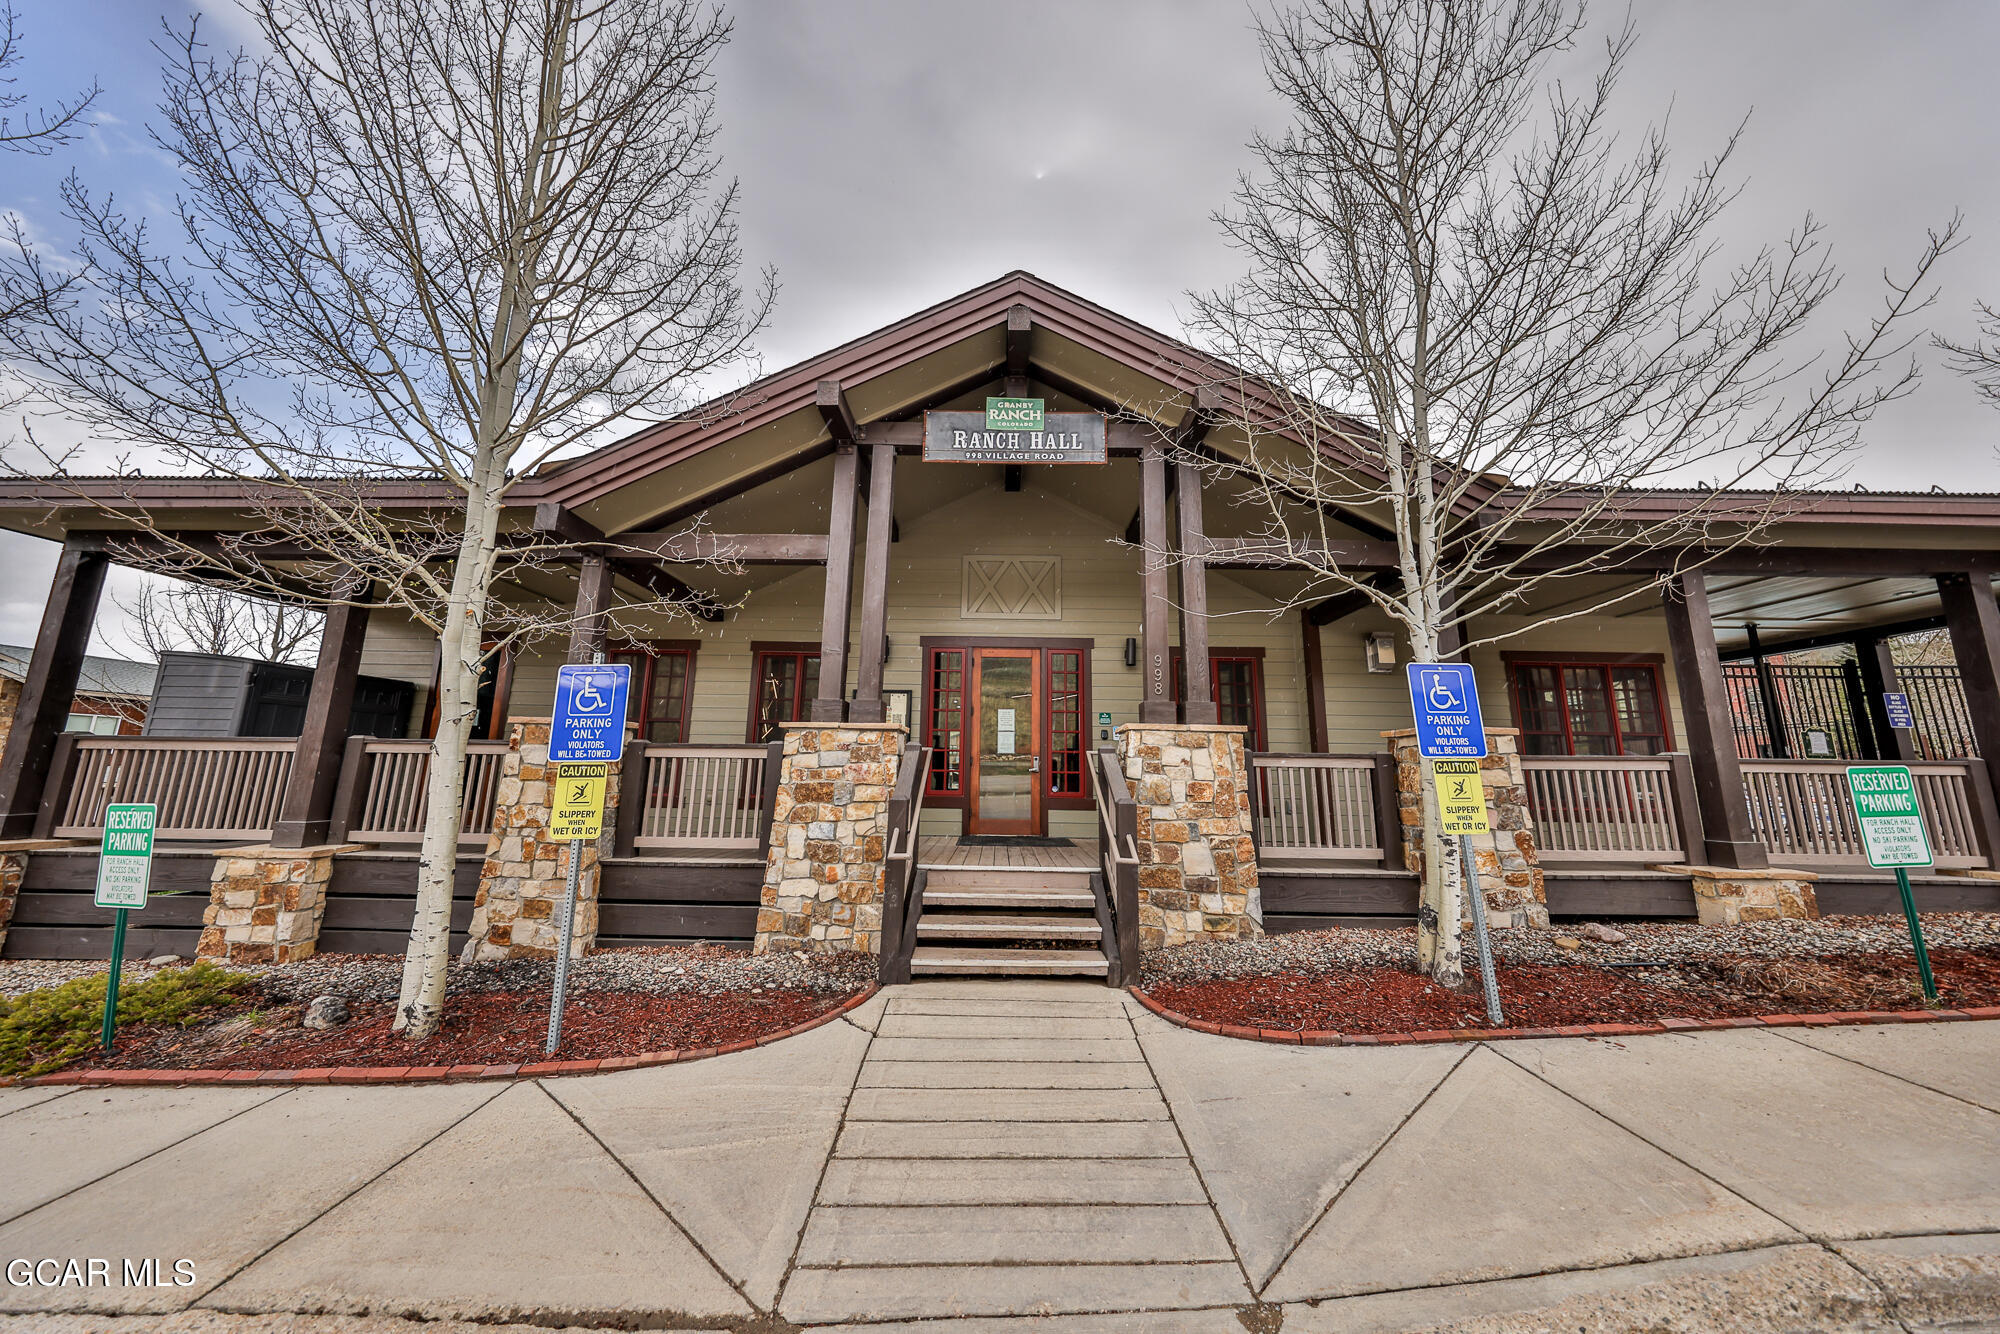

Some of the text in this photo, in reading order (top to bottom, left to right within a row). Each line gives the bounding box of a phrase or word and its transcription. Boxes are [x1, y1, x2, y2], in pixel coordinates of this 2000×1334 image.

[989, 409, 1042, 420] RANCH
[953, 430, 1083, 450] RANCH HALL
[985, 452, 1030, 460] VILLAGE
[1154, 654, 1163, 695] 998
[565, 718, 612, 728] PARKING
[1427, 715, 1471, 725] PARKING
[572, 729, 602, 739] ONLY
[1436, 726, 1463, 736] ONLY
[568, 741, 605, 749] VIOLATORS
[1435, 737, 1469, 746] VIOLATORS
[557, 750, 611, 758] WILL BE TOWED
[1428, 746, 1478, 754] WILL BE TOWED
[561, 765, 605, 777] CAUTION
[1436, 762, 1477, 773] CAUTION
[1852, 773, 1909, 791] RESERVED
[1860, 793, 1912, 812] PARKING
[559, 810, 596, 818] SLIPPERY
[1446, 806, 1480, 814] SLIPPERY
[108, 811, 153, 829] RESERVED
[553, 827, 599, 835] WET OR ICY
[1445, 823, 1461, 831] WET
[1474, 822, 1486, 830] ICY
[107, 832, 148, 851] PARKING
